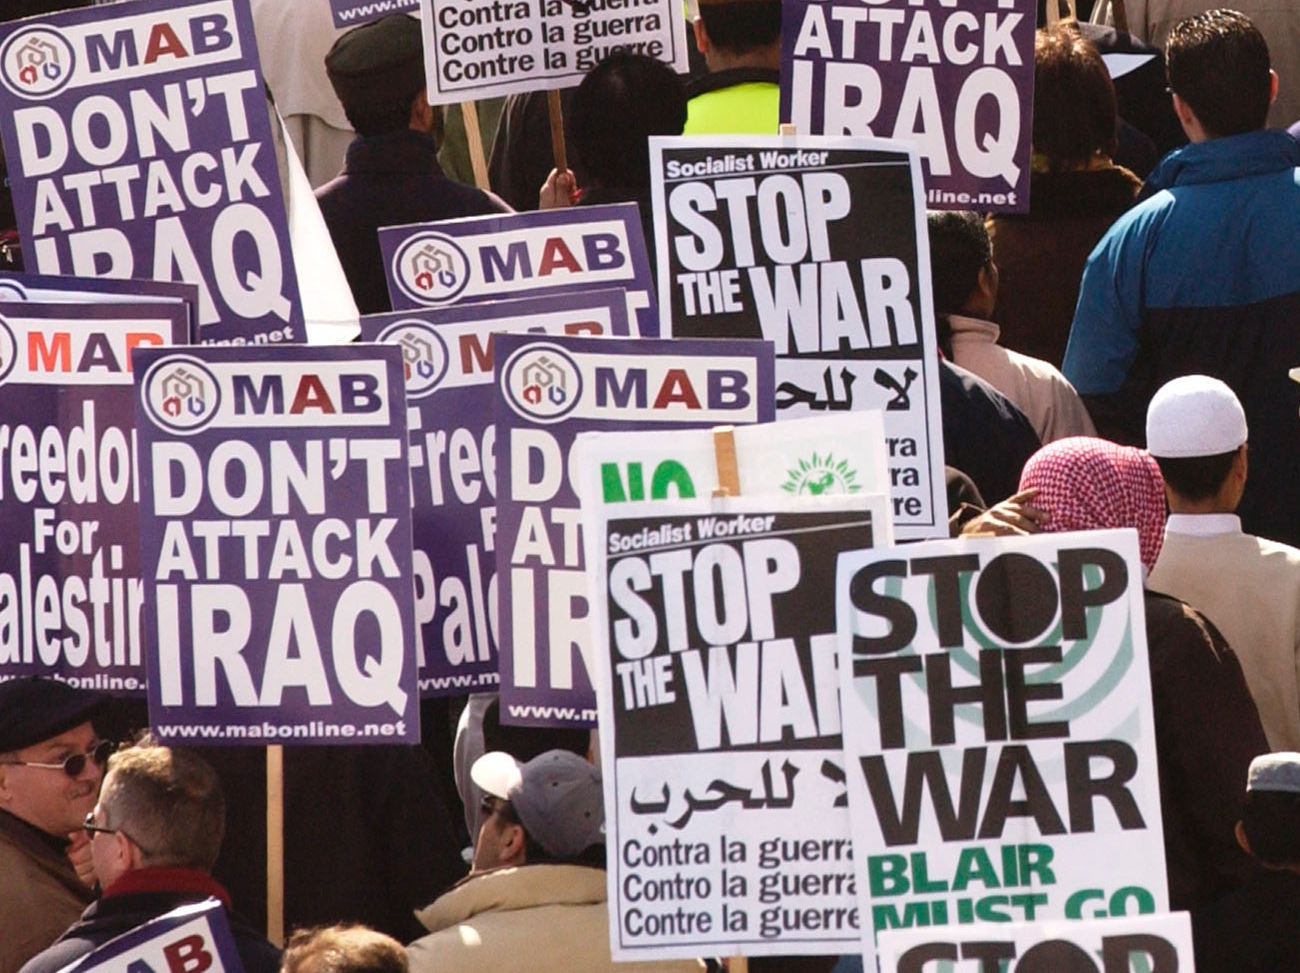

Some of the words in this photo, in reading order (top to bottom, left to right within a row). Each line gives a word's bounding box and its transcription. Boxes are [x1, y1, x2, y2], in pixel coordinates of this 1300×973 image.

[438, 0, 530, 29] Contra
[441, 26, 533, 56] Contro
[542, 19, 566, 44] la
[573, 12, 661, 45] guerra
[795, 4, 1023, 65] ATTACK
[85, 13, 234, 73] MAB
[444, 52, 535, 82] Contre
[544, 45, 567, 70] la
[13, 70, 257, 177] DON'T
[32, 142, 270, 236] ATTACK
[667, 155, 754, 176] Socialist
[758, 150, 829, 171] Worker
[668, 173, 851, 271] STOP
[678, 269, 743, 316] THE
[233, 374, 382, 415] MAB
[595, 367, 750, 409] MAB
[152, 438, 401, 517] DON'T
[35, 508, 99, 555] For
[156, 518, 400, 581] ATTACK
[609, 517, 692, 553] Socialist
[698, 514, 775, 535] Worker
[609, 539, 800, 660] STOP
[850, 547, 1128, 657] STOP
[157, 580, 408, 716] IRAQ
[616, 655, 676, 710] THE
[853, 646, 1070, 750] THE
[158, 722, 406, 738] www.mabonline.net
[630, 757, 800, 834] للحرب
[859, 739, 1147, 847] WAR
[623, 838, 710, 868] Contra
[721, 835, 747, 863] la
[868, 843, 1056, 898] BLAIR
[623, 875, 711, 903] Contro
[722, 872, 747, 899] la
[1065, 886, 1155, 919] GO
[624, 908, 712, 937] Contre
[722, 906, 748, 934] la
